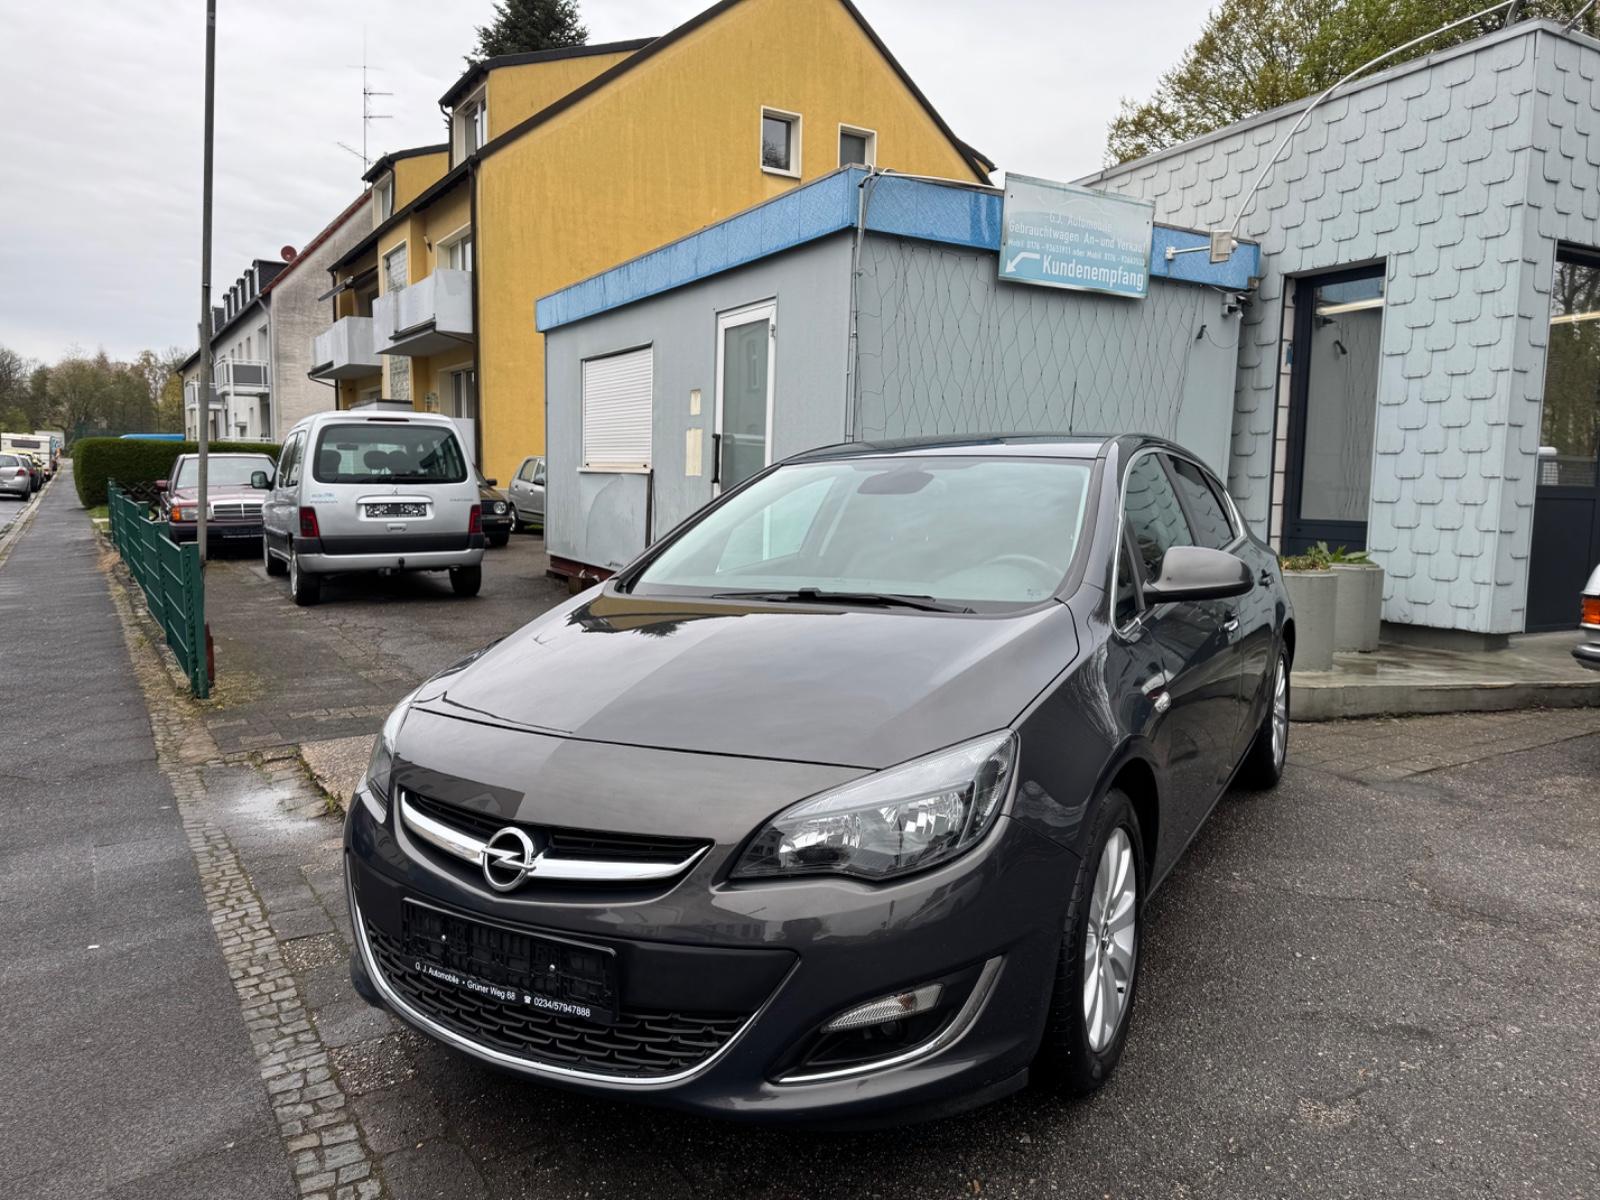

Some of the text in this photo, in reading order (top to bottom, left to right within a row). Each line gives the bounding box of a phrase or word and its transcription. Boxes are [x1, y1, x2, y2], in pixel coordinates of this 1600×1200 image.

[1009, 221, 1146, 253] Gebrauchtwagen An- und Verkauf
[1042, 254, 1144, 291] Kundenempfang
[428, 968, 459, 984] Automobile
[489, 986, 506, 1000] Weg
[534, 998, 591, 1017] 0234/57947888
